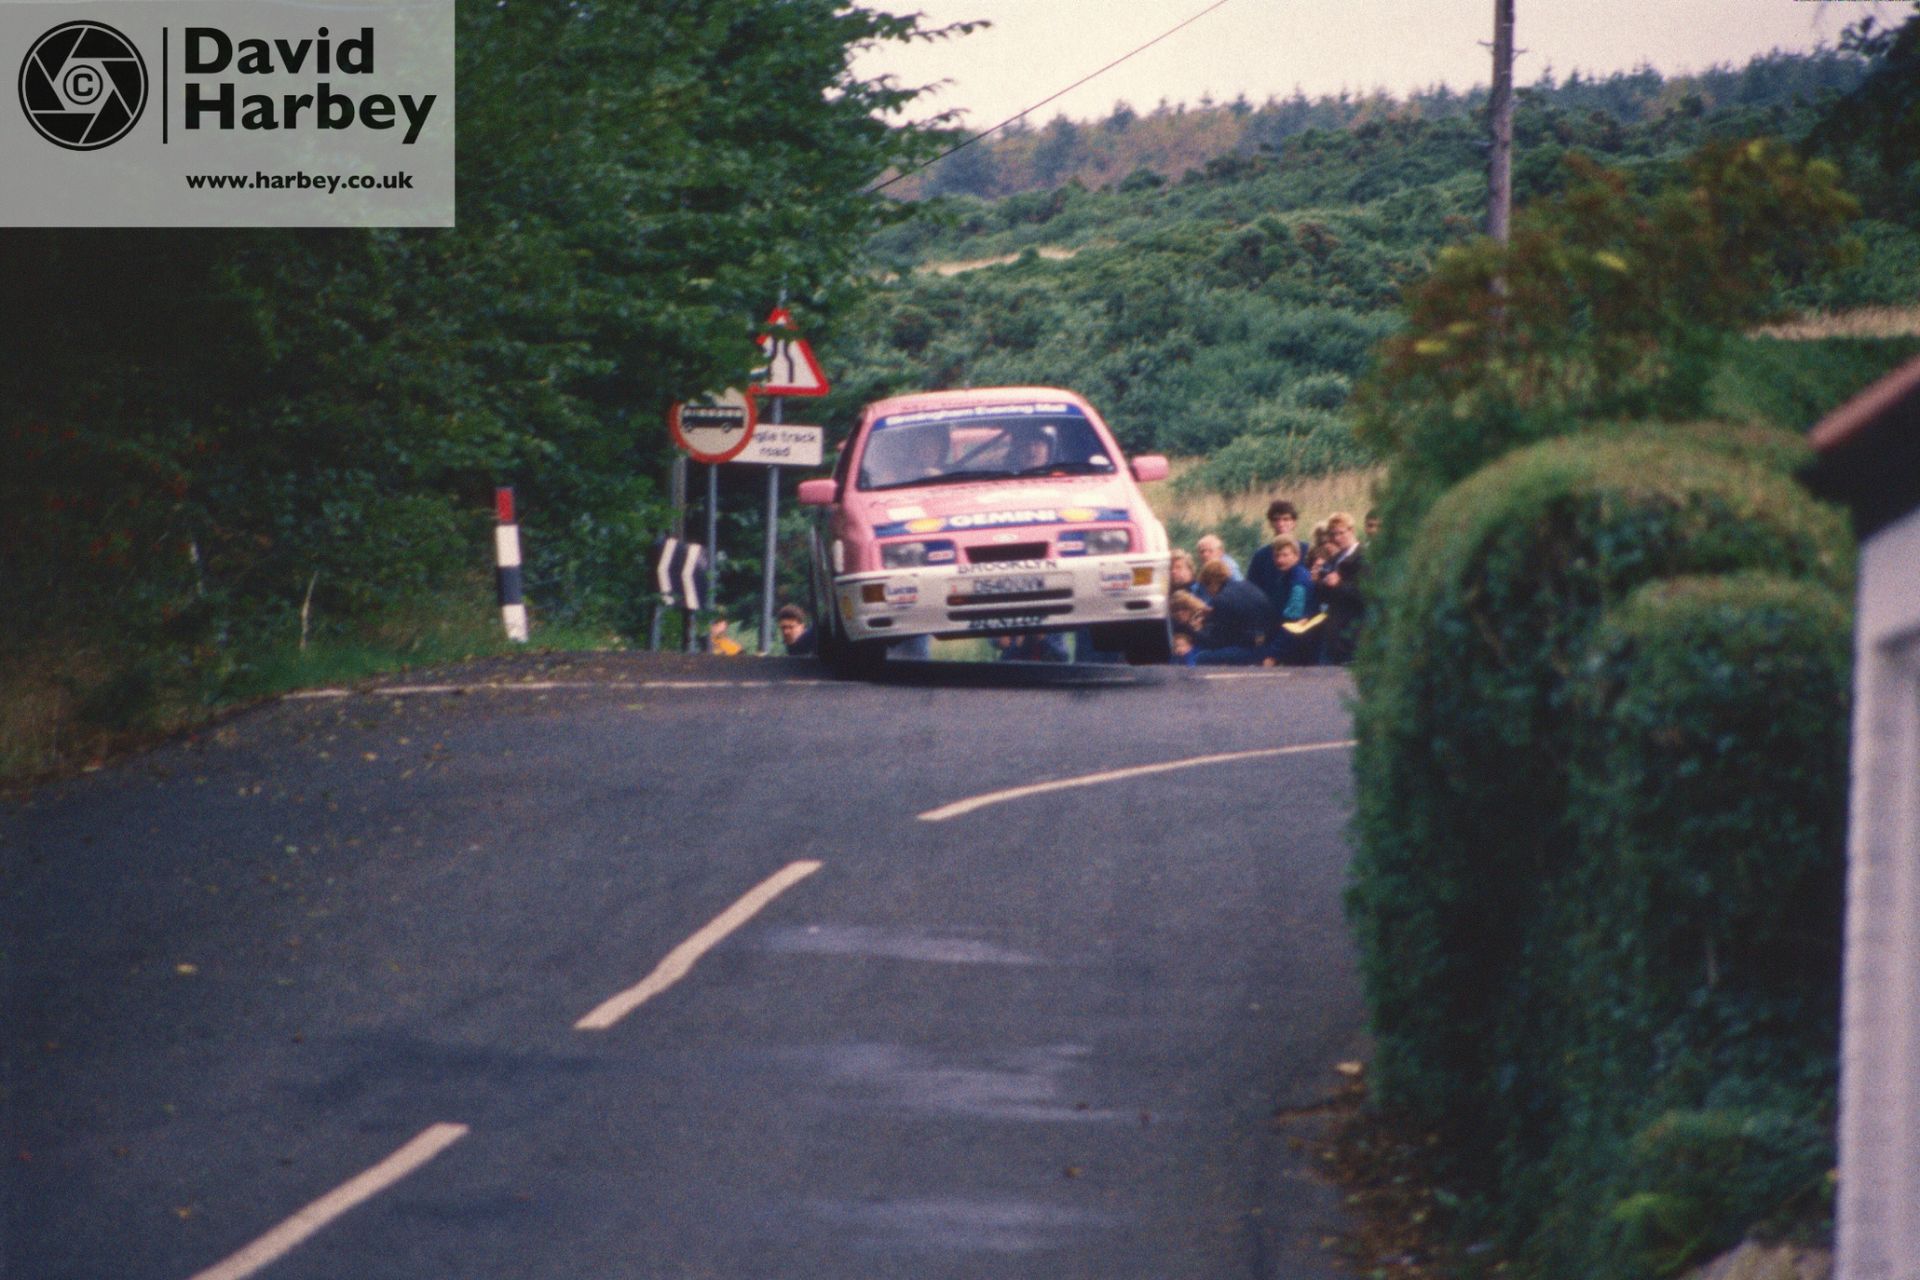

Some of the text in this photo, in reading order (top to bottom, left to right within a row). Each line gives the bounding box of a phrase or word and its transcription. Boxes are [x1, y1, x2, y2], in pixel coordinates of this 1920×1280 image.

[758, 446, 791, 458] road
[948, 509, 1056, 528] GEMINI
[957, 559, 1057, 575] BROOKLYN
